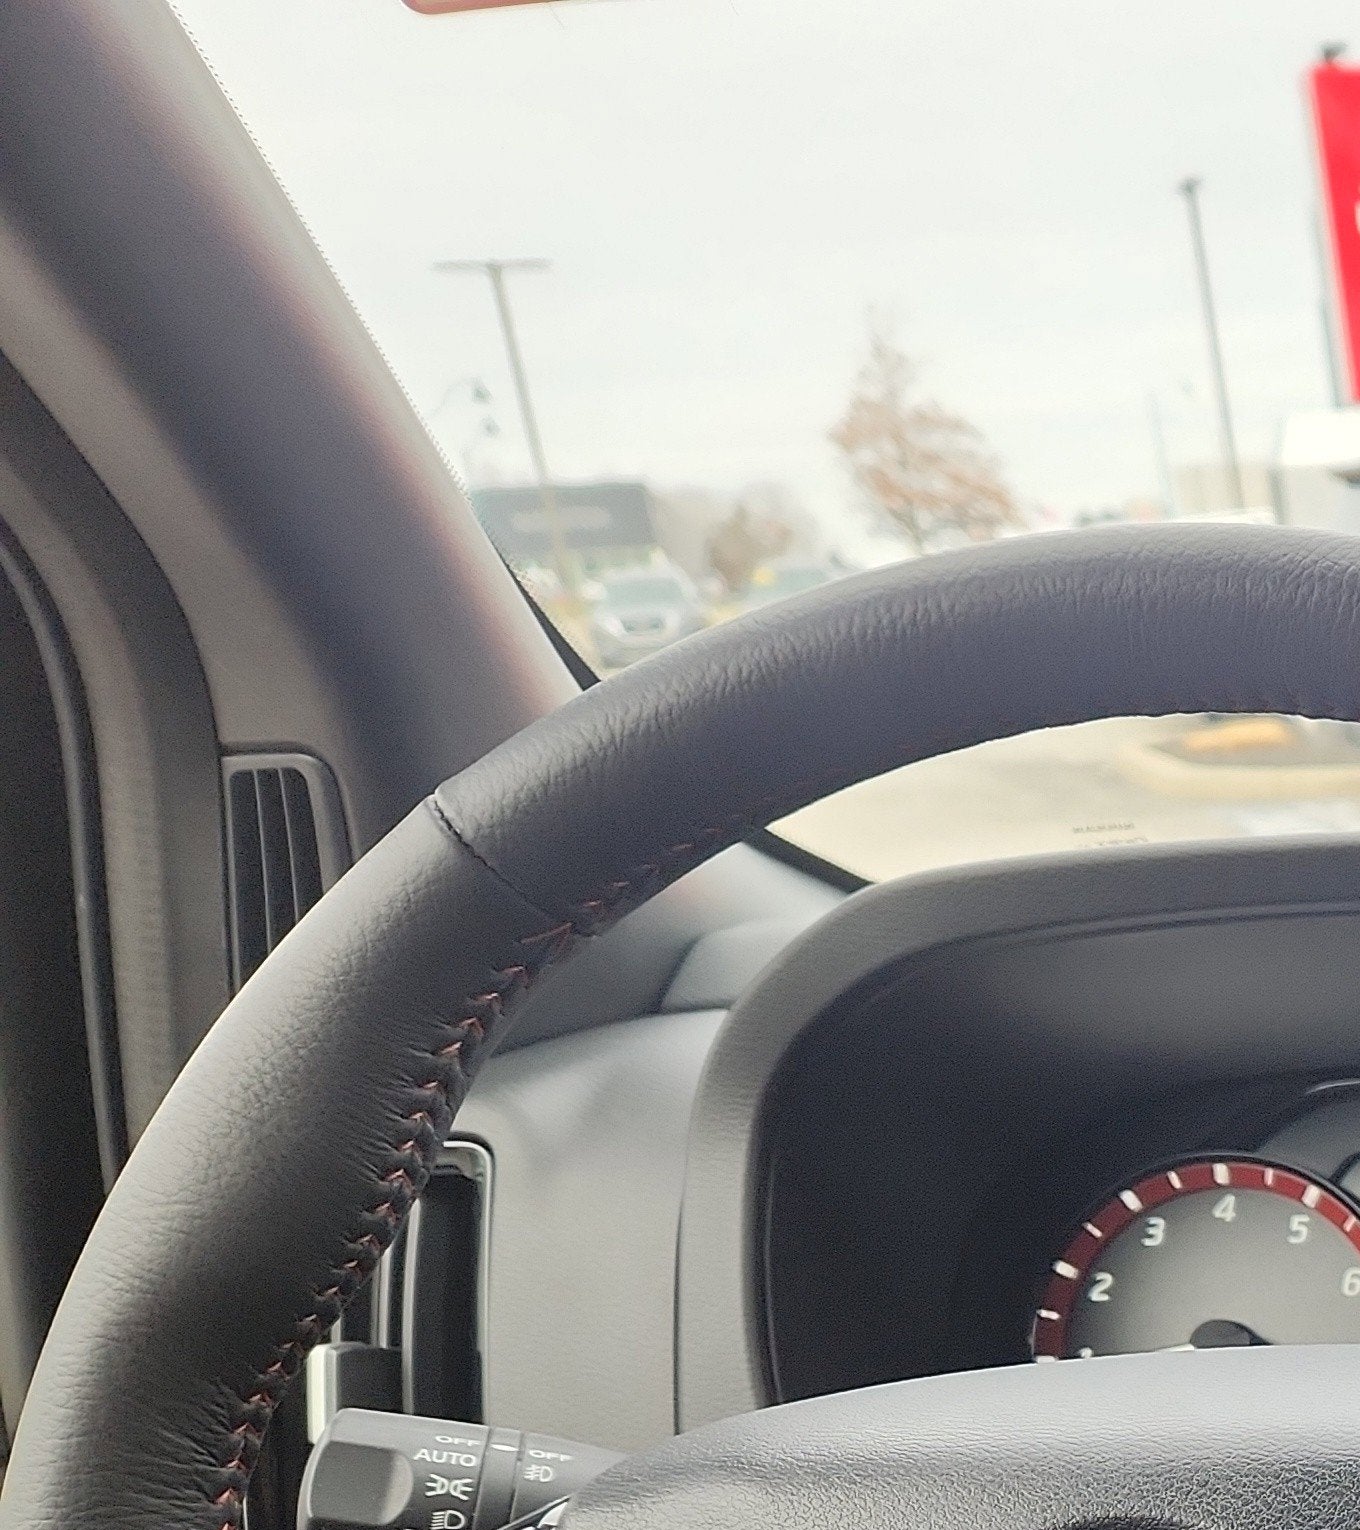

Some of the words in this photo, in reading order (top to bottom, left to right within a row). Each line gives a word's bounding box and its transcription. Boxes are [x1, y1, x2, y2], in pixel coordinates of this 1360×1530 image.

[1212, 1193, 1237, 1223] 4
[1140, 1216, 1167, 1247] 3
[1286, 1214, 1310, 1244] 5
[1087, 1271, 1114, 1302] 2
[435, 1434, 482, 1448] OFF
[528, 1449, 573, 1462] OFF
[413, 1447, 477, 1468] AUTO
